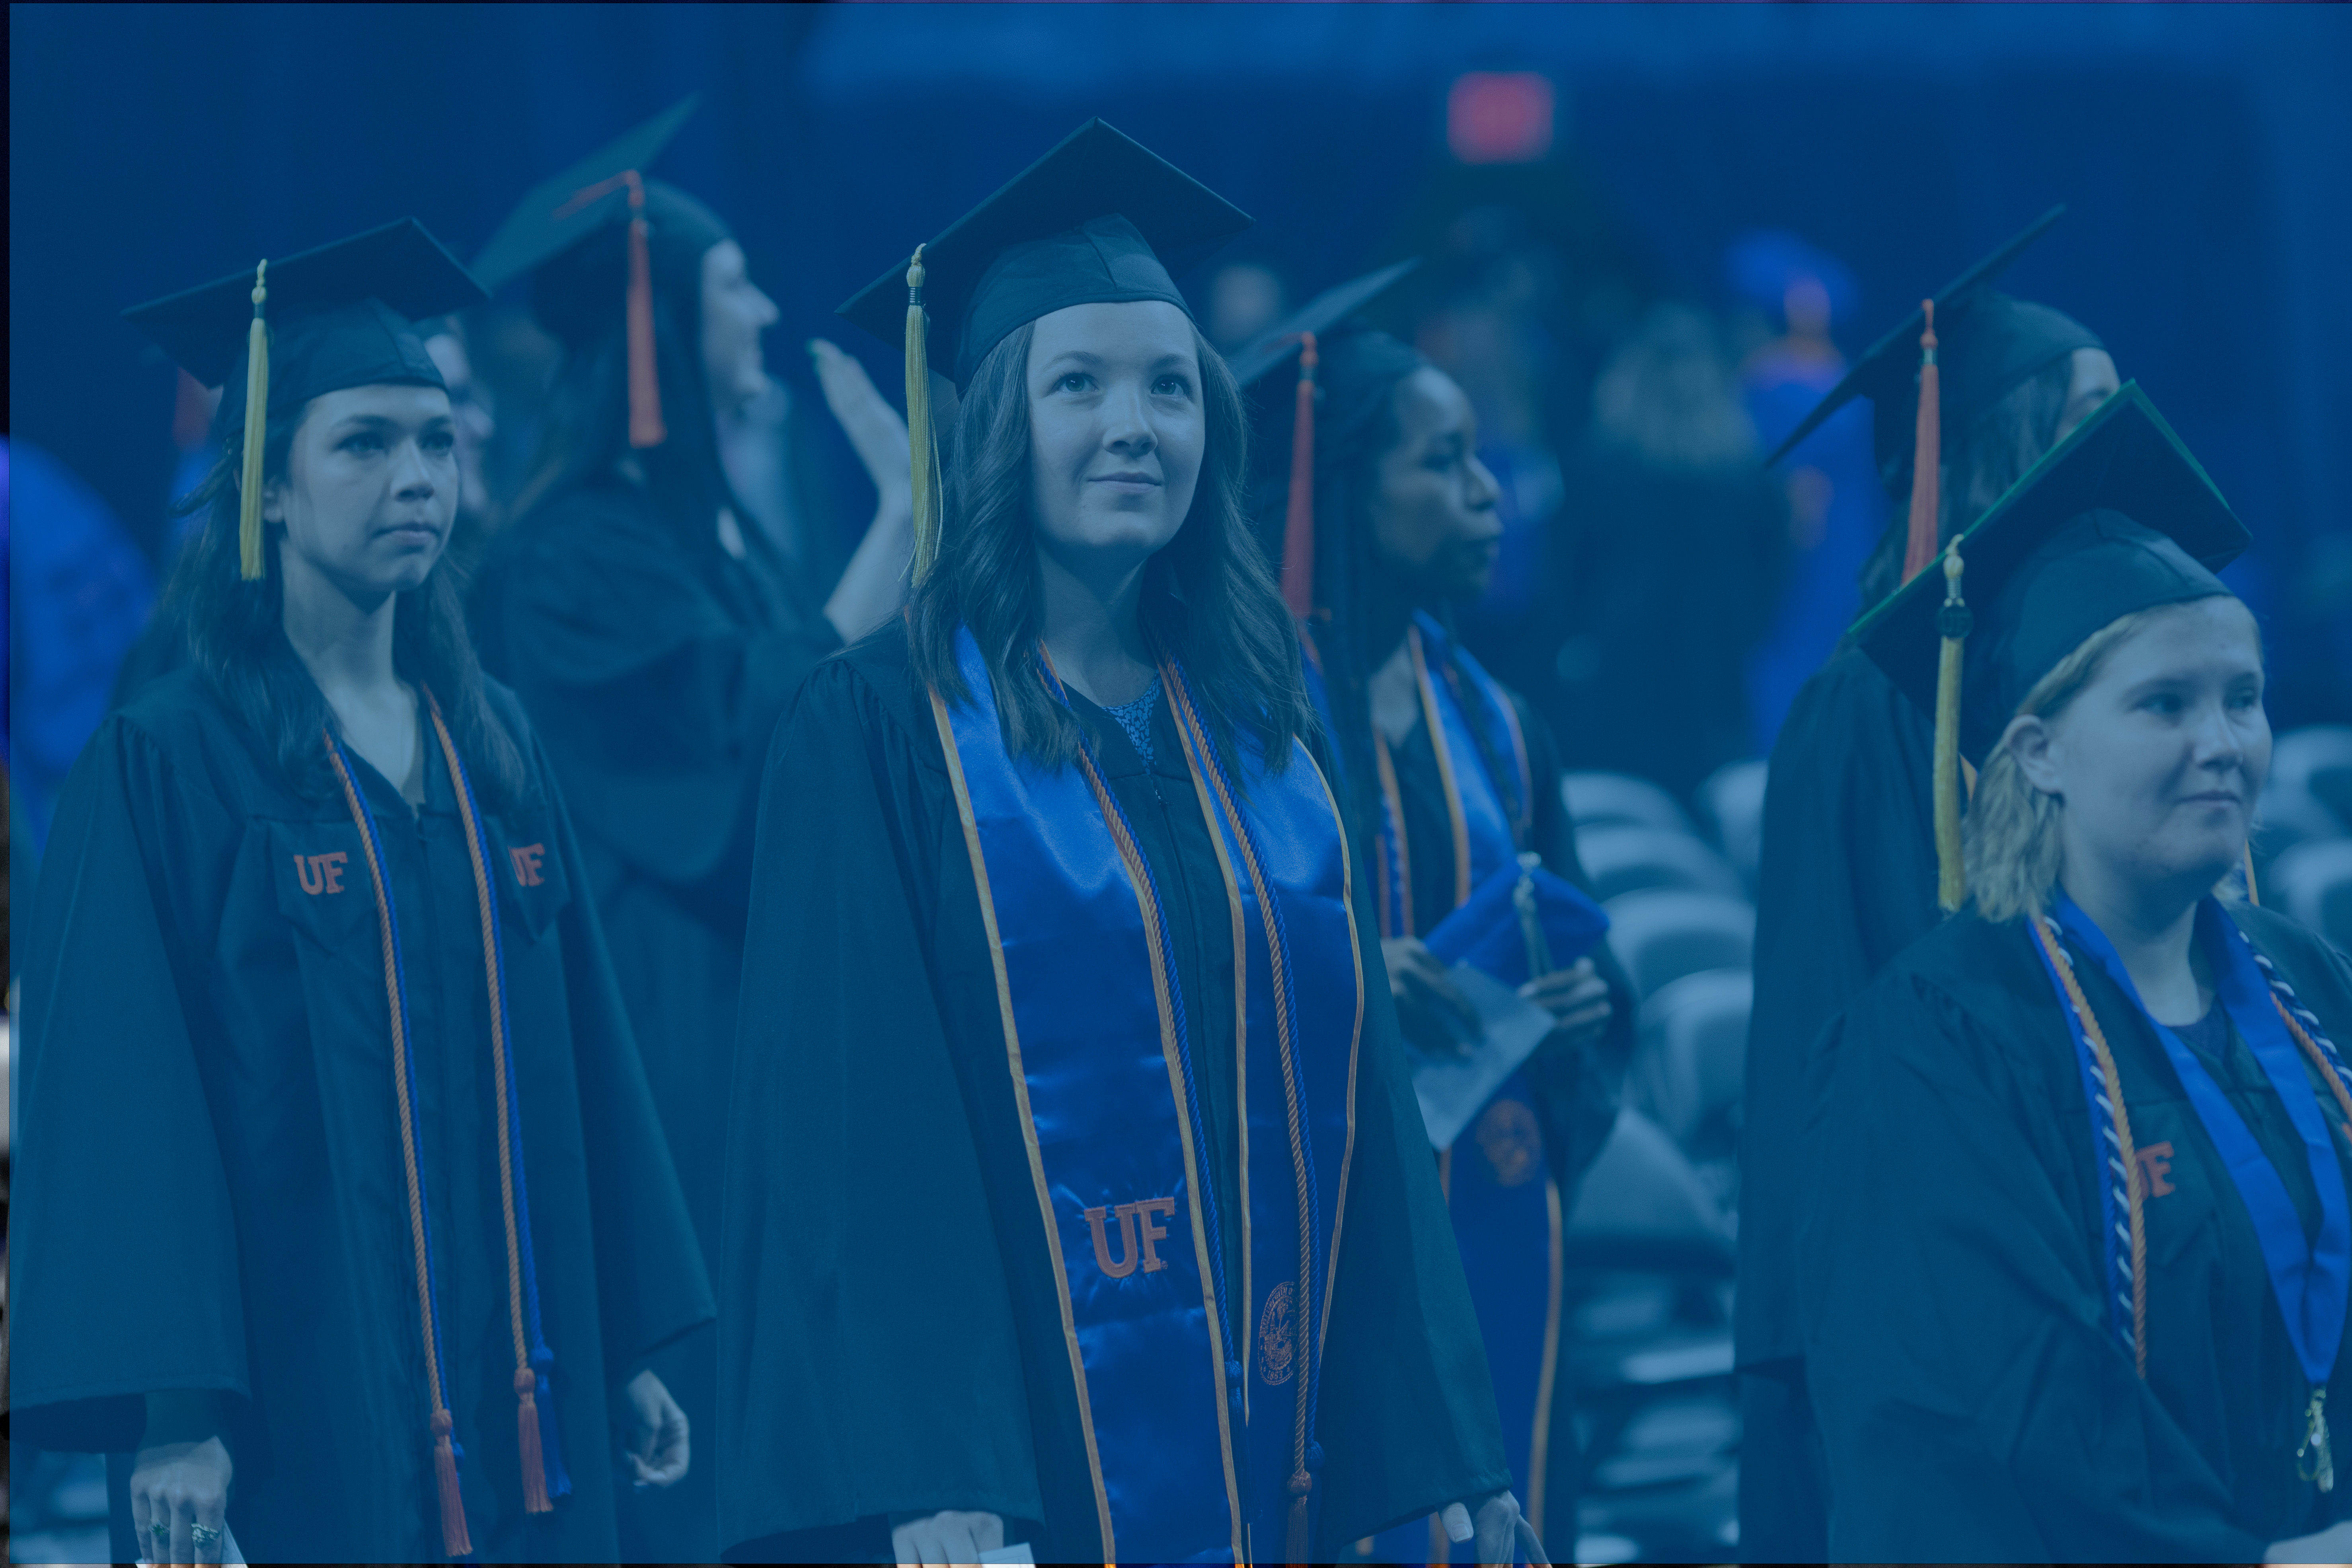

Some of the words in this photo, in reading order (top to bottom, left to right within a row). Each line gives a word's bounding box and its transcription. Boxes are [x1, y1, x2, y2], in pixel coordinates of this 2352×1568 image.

[293, 851, 348, 896] UF
[1083, 1197, 1175, 1279] UF
[1267, 1370, 1283, 1380] 1853
